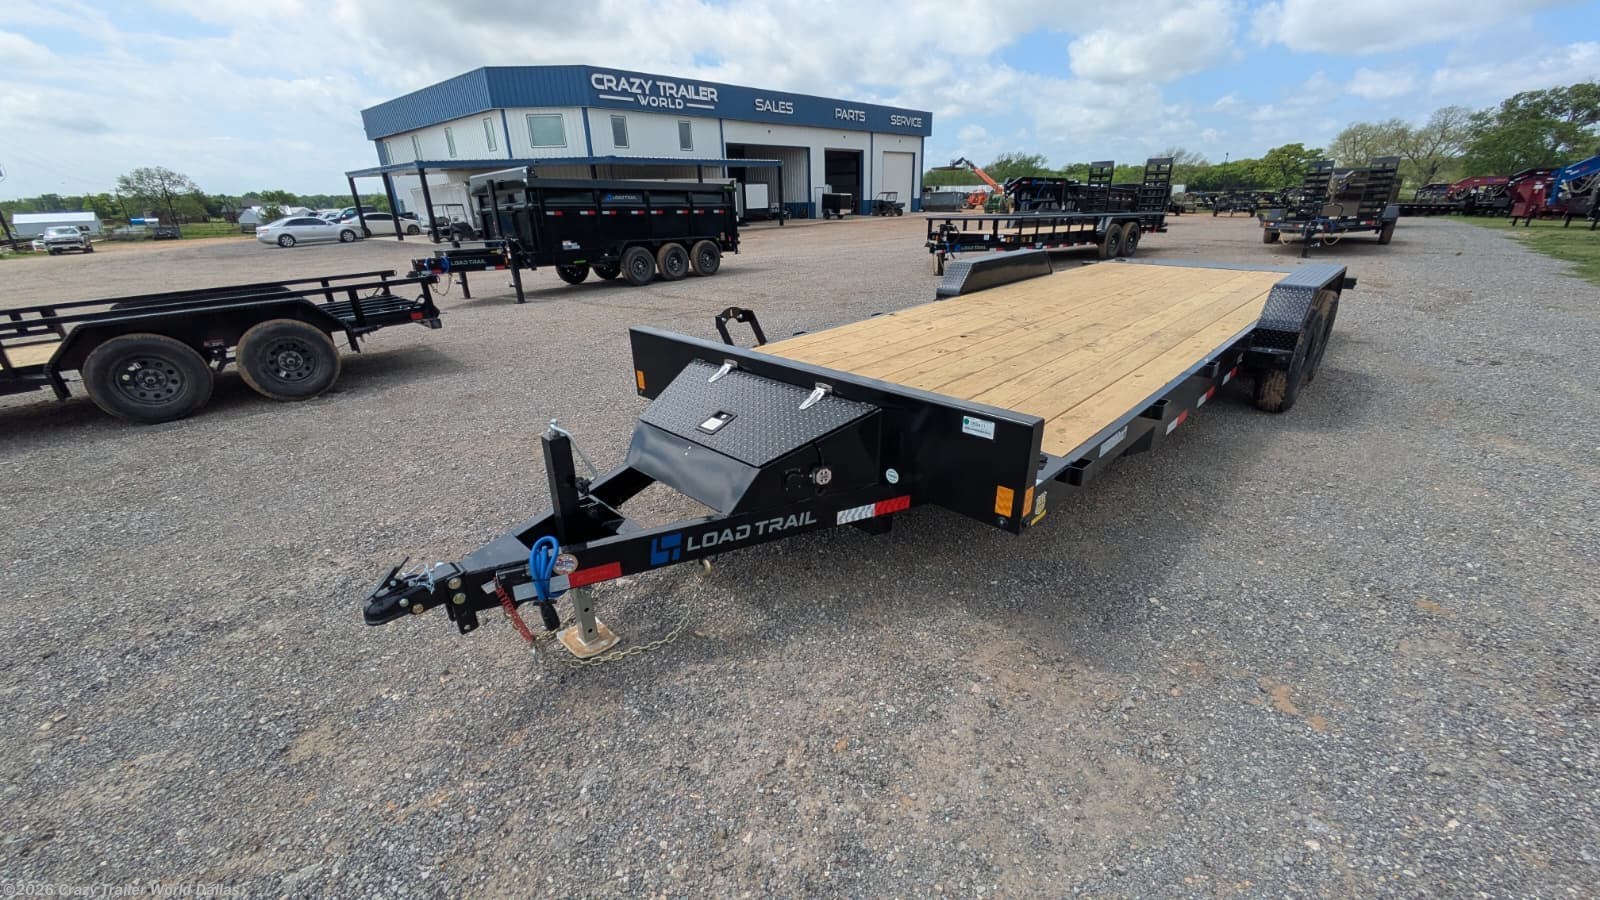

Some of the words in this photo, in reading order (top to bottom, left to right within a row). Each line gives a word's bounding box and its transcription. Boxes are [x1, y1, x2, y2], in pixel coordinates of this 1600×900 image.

[591, 73, 652, 95] CRAZY
[656, 81, 718, 102] TRAILER
[637, 94, 684, 109] WORLD
[755, 98, 794, 115] SALES
[835, 108, 866, 122] PARTS
[890, 114, 922, 128] SERVICE
[687, 524, 751, 551] LOAD
[755, 511, 817, 535] TRAIL
